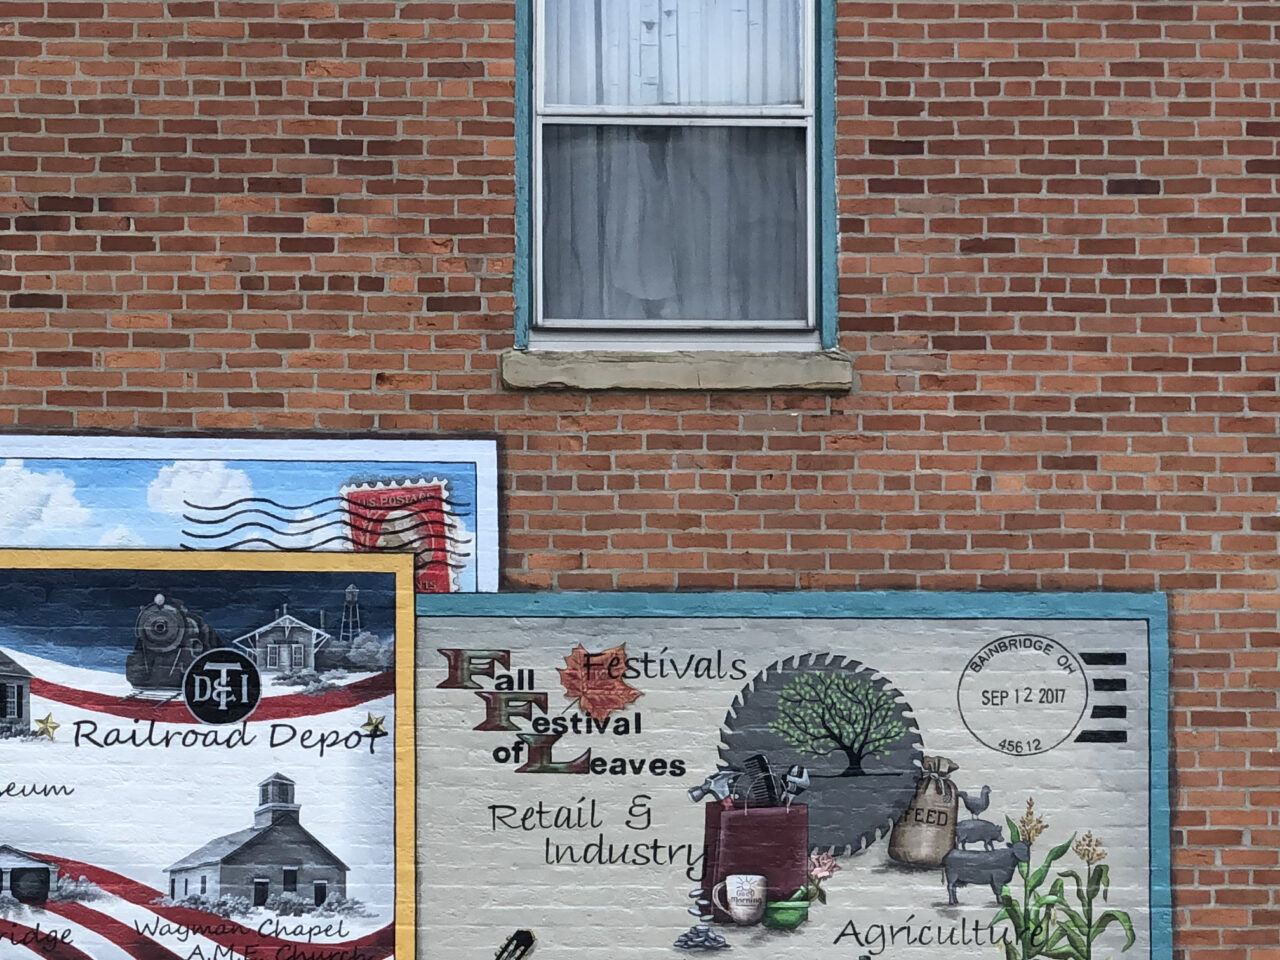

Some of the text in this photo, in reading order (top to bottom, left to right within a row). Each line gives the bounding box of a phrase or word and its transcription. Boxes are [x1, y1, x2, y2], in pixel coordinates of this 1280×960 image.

[435, 648, 535, 691] Fall
[583, 646, 747, 681] Festivals
[970, 637, 1077, 675] BAINBRIDGE OH
[472, 691, 642, 736] Festival
[981, 690, 1009, 706] SEP
[1038, 688, 1066, 704] 2017
[72, 719, 389, 757] Railroad Depot
[492, 733, 687, 777] of Leaves
[998, 738, 1042, 754] 45612
[488, 794, 652, 831] Retail &
[904, 807, 948, 827] FEED
[545, 833, 709, 882] Industry
[134, 917, 350, 943] Wayman Chapel
[833, 914, 1047, 955] Agriculture
